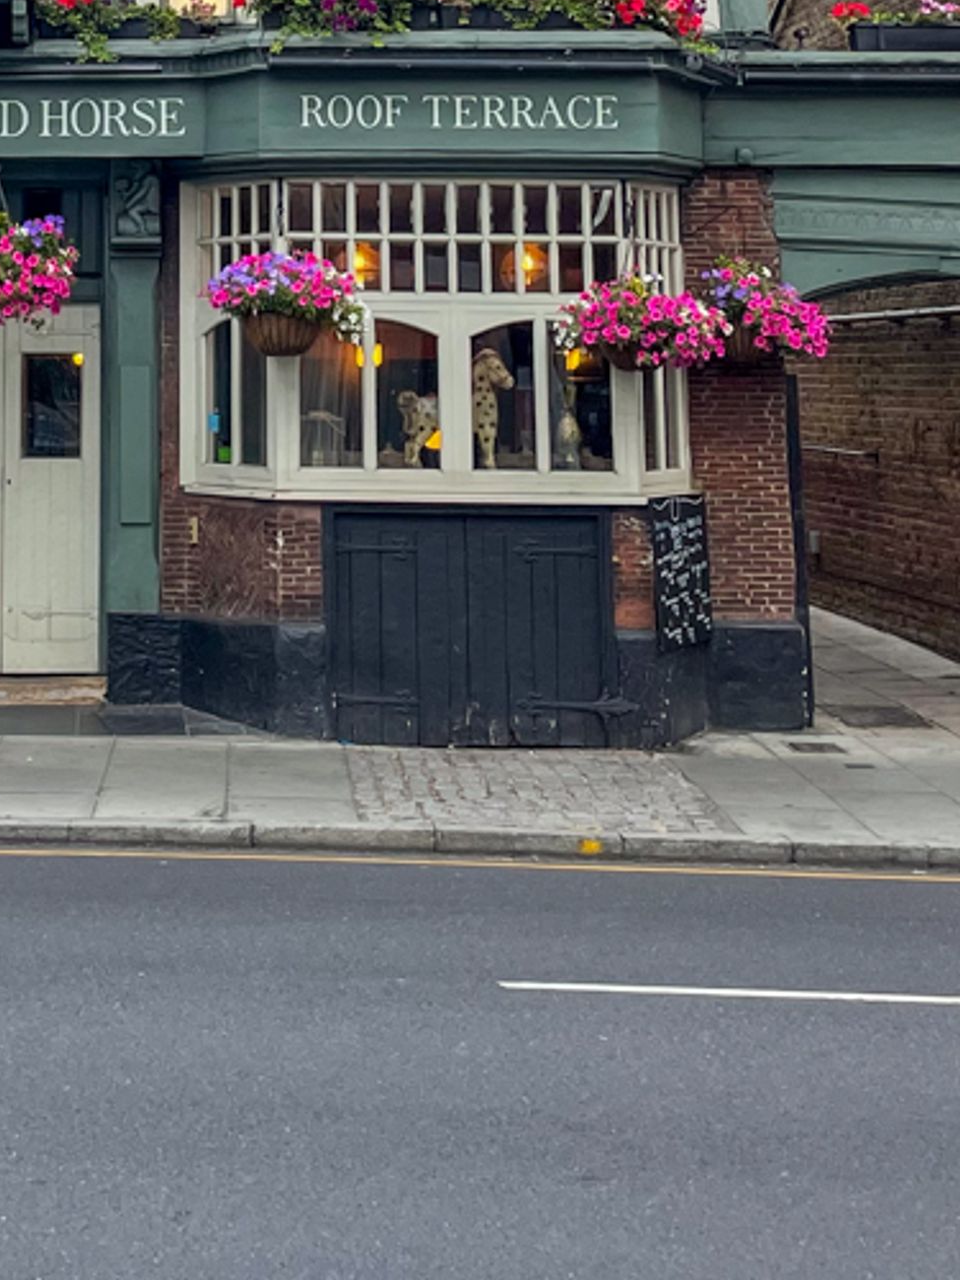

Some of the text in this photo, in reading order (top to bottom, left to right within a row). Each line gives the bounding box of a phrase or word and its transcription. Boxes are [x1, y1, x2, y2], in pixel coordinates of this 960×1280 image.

[38, 96, 187, 138] HORSE
[299, 94, 619, 129] ROOF TERRACE
